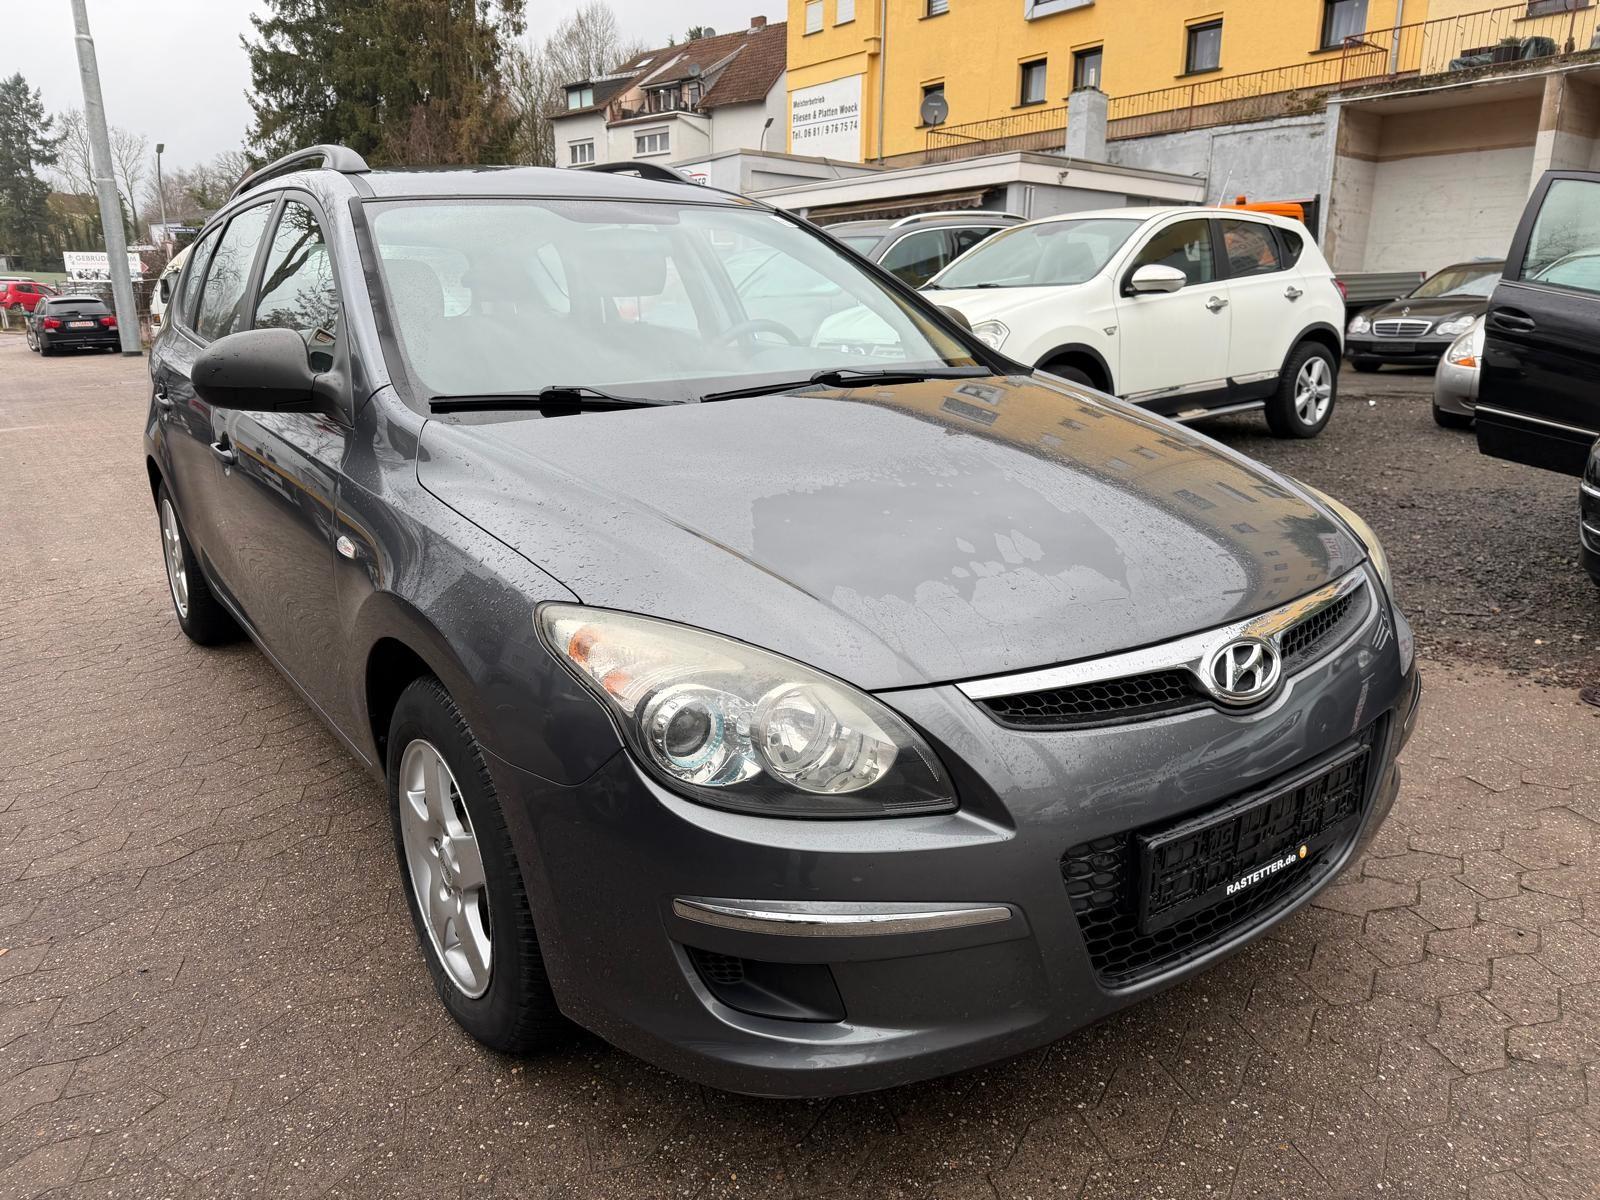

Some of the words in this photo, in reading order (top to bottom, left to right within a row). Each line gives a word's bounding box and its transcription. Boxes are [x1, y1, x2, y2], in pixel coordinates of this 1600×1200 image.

[793, 96, 825, 108] Meisterbetrieb
[793, 113, 811, 123] Fliesen
[818, 107, 838, 118] Platten
[840, 102, 858, 114] Woock
[792, 130, 803, 140] Tel.
[1226, 854, 1297, 895] RASTETTER.de
